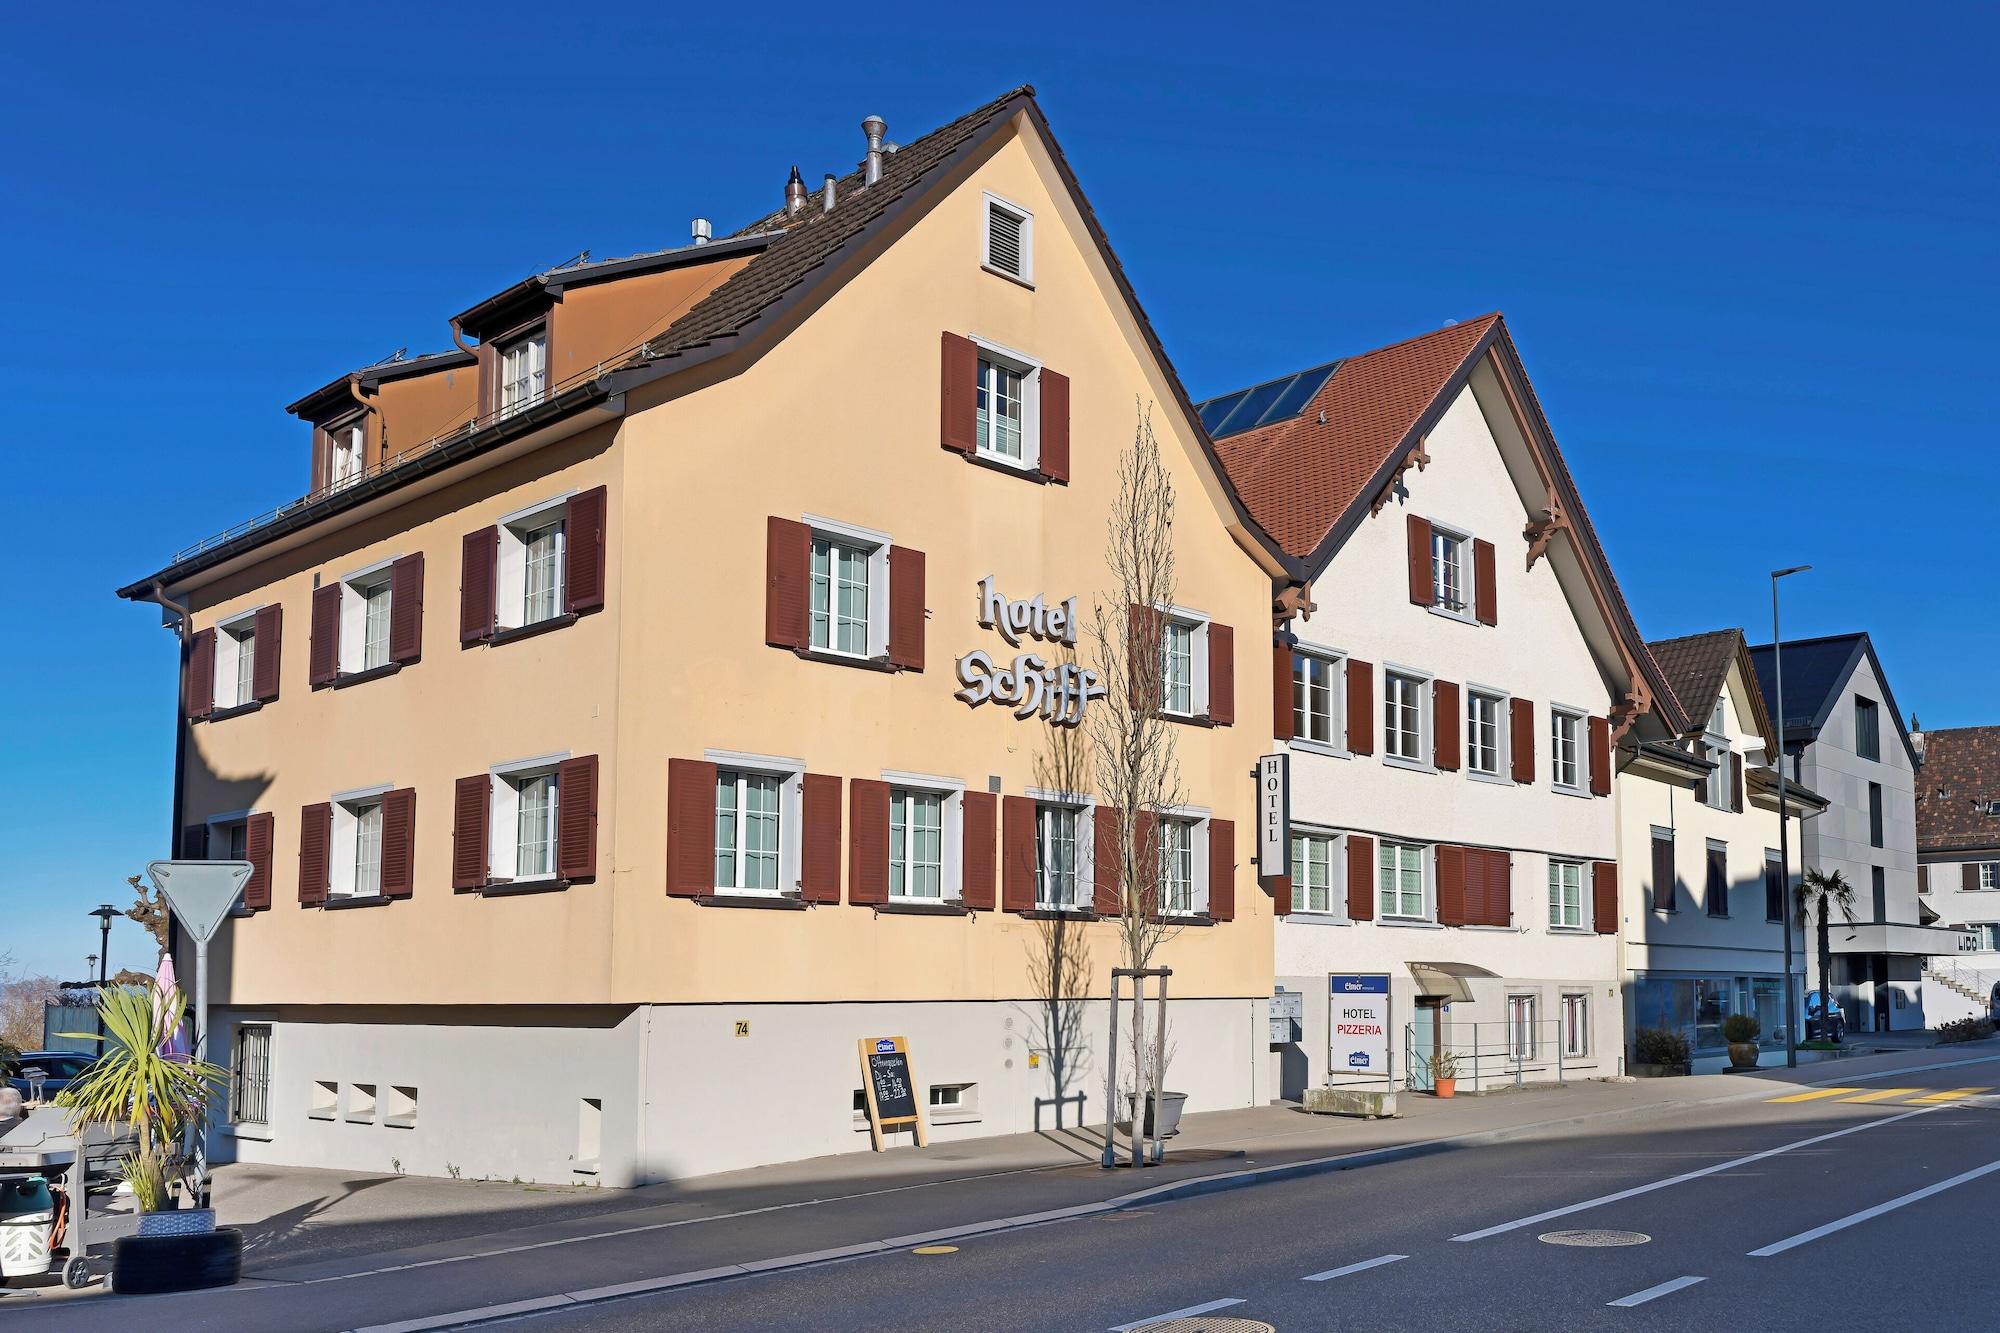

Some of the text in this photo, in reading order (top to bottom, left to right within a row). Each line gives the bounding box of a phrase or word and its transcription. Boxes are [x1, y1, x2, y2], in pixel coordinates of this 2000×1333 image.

[954, 650, 1106, 729] Schiff
[1267, 760, 1278, 842] HOTEL
[1957, 935, 1977, 951] LIDO
[1343, 1008, 1376, 1019] HOTEL
[736, 1022, 748, 1035] 74
[1337, 1024, 1382, 1035] PIZZERIA
